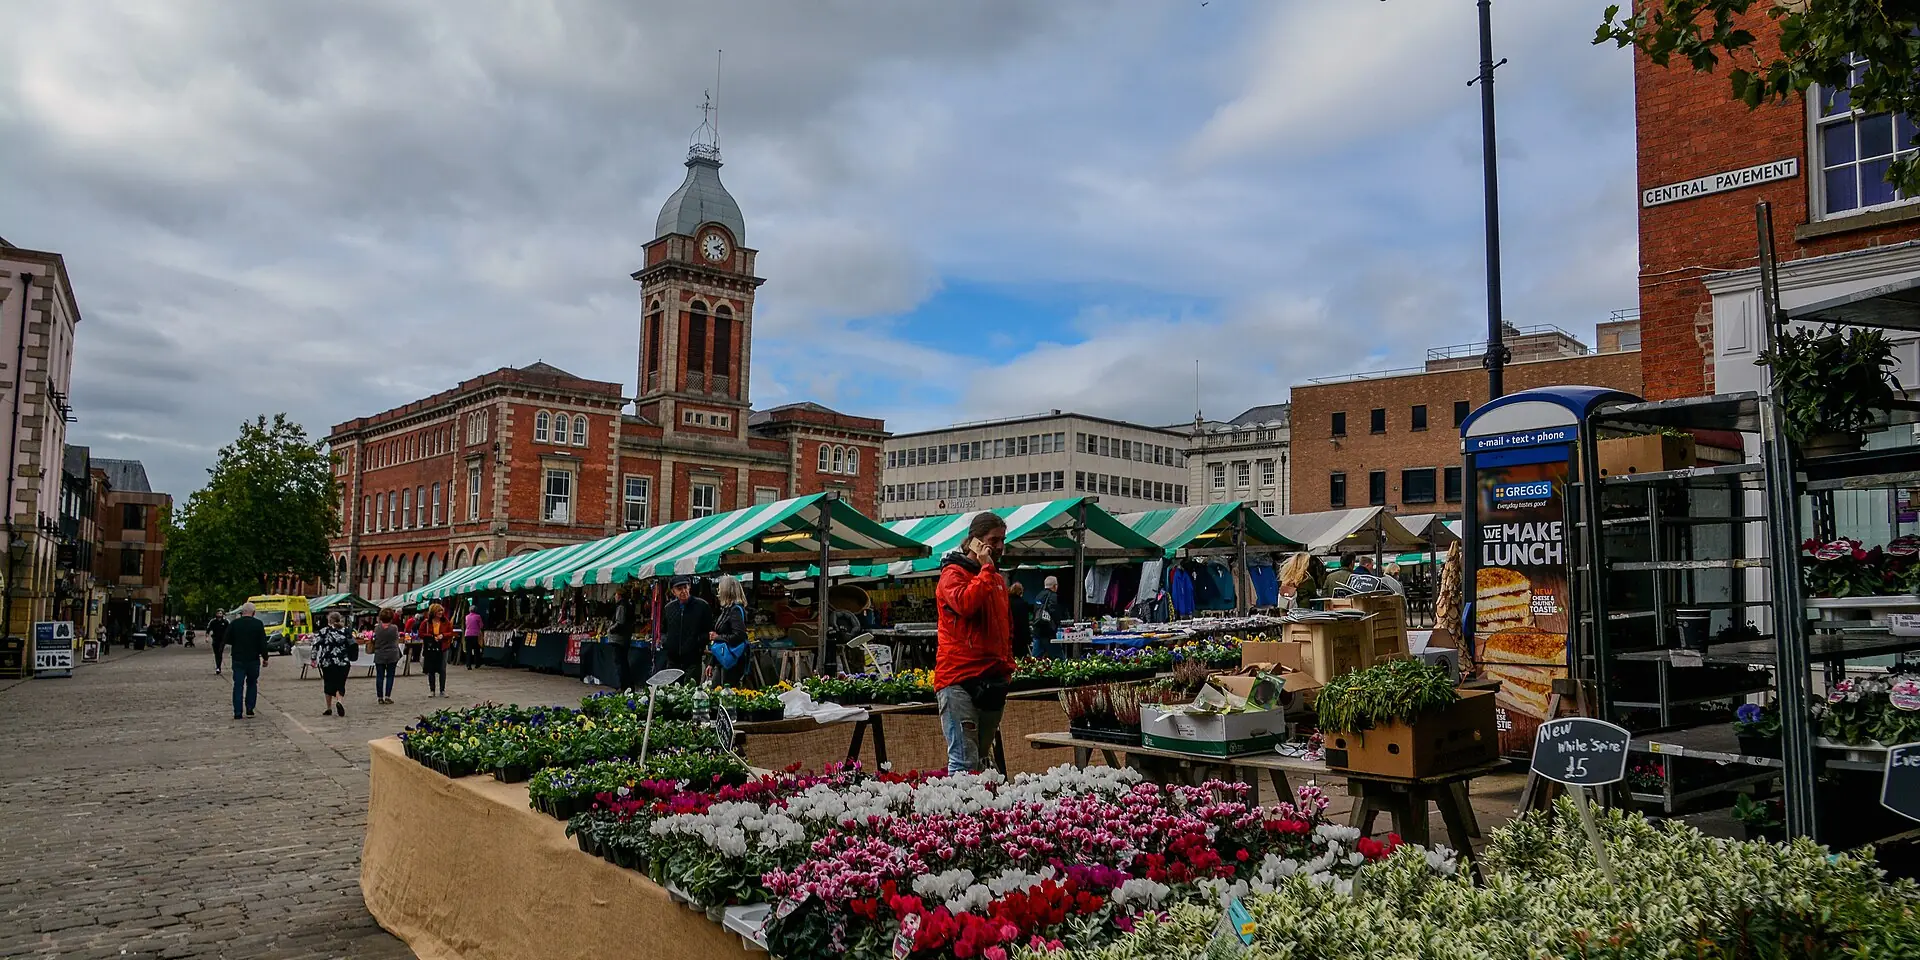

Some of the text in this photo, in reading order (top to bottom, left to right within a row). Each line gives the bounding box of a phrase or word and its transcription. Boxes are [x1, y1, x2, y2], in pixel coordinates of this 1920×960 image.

[1645, 160, 1794, 204] CENTRAL PAVEMENT
[1478, 431, 1565, 448] e-mail text phone
[1505, 484, 1549, 497] GREGGS
[947, 498, 976, 509] NatWest
[1533, 500, 1547, 508] good
[1484, 521, 1562, 542] WE MAKE
[1483, 542, 1562, 566] LUNCH
[1530, 605, 1557, 613] TOASTIE
[1540, 722, 1573, 743] New
[1564, 756, 1590, 779] £5
